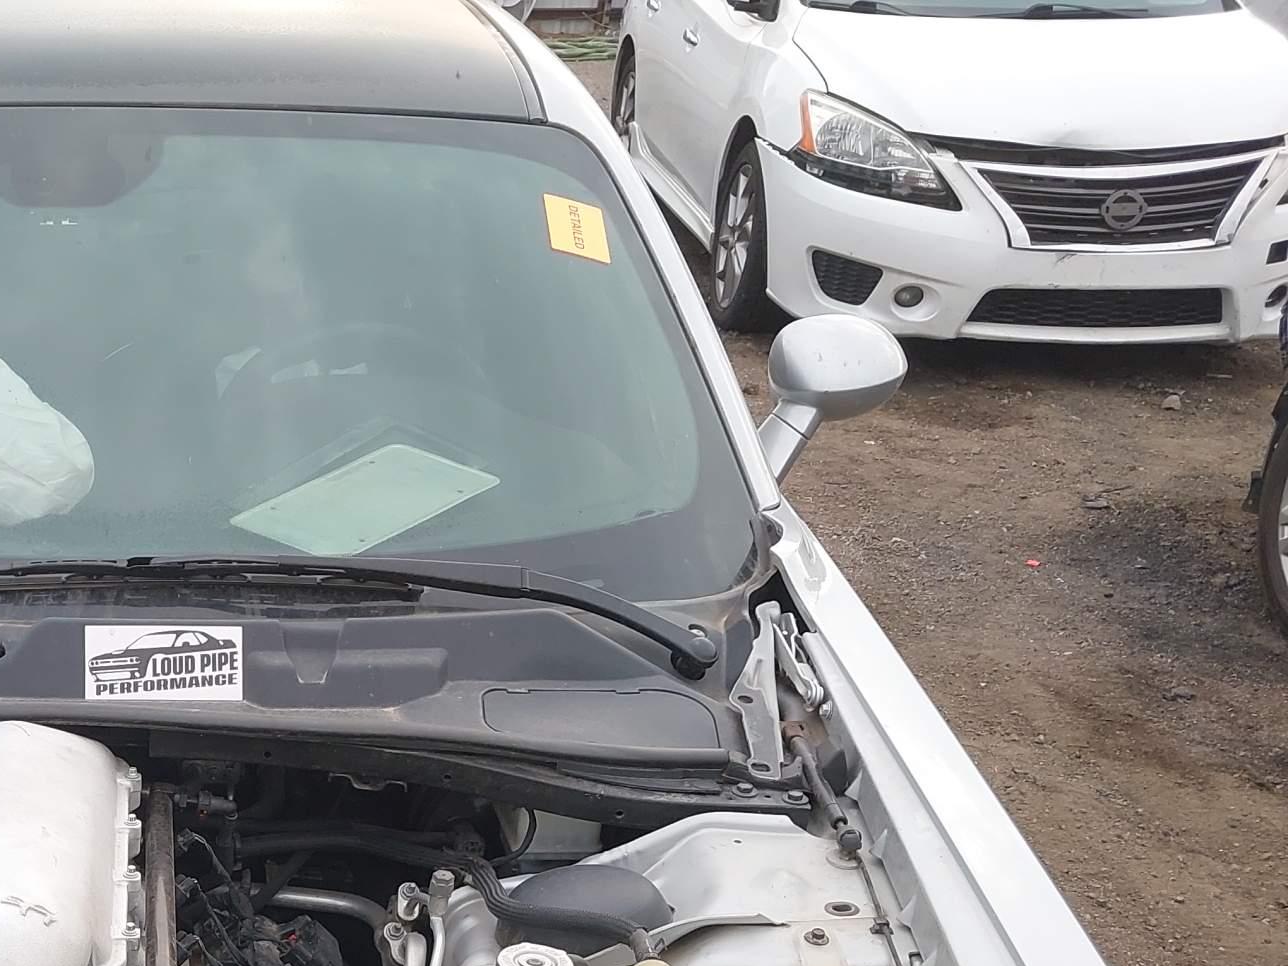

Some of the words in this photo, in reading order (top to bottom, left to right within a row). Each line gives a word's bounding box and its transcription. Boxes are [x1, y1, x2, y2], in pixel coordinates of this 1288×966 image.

[568, 205, 585, 250] DETAILED
[152, 655, 196, 677] LOUD
[200, 651, 239, 673] PIPE
[95, 672, 238, 696] PERFORMANCE
